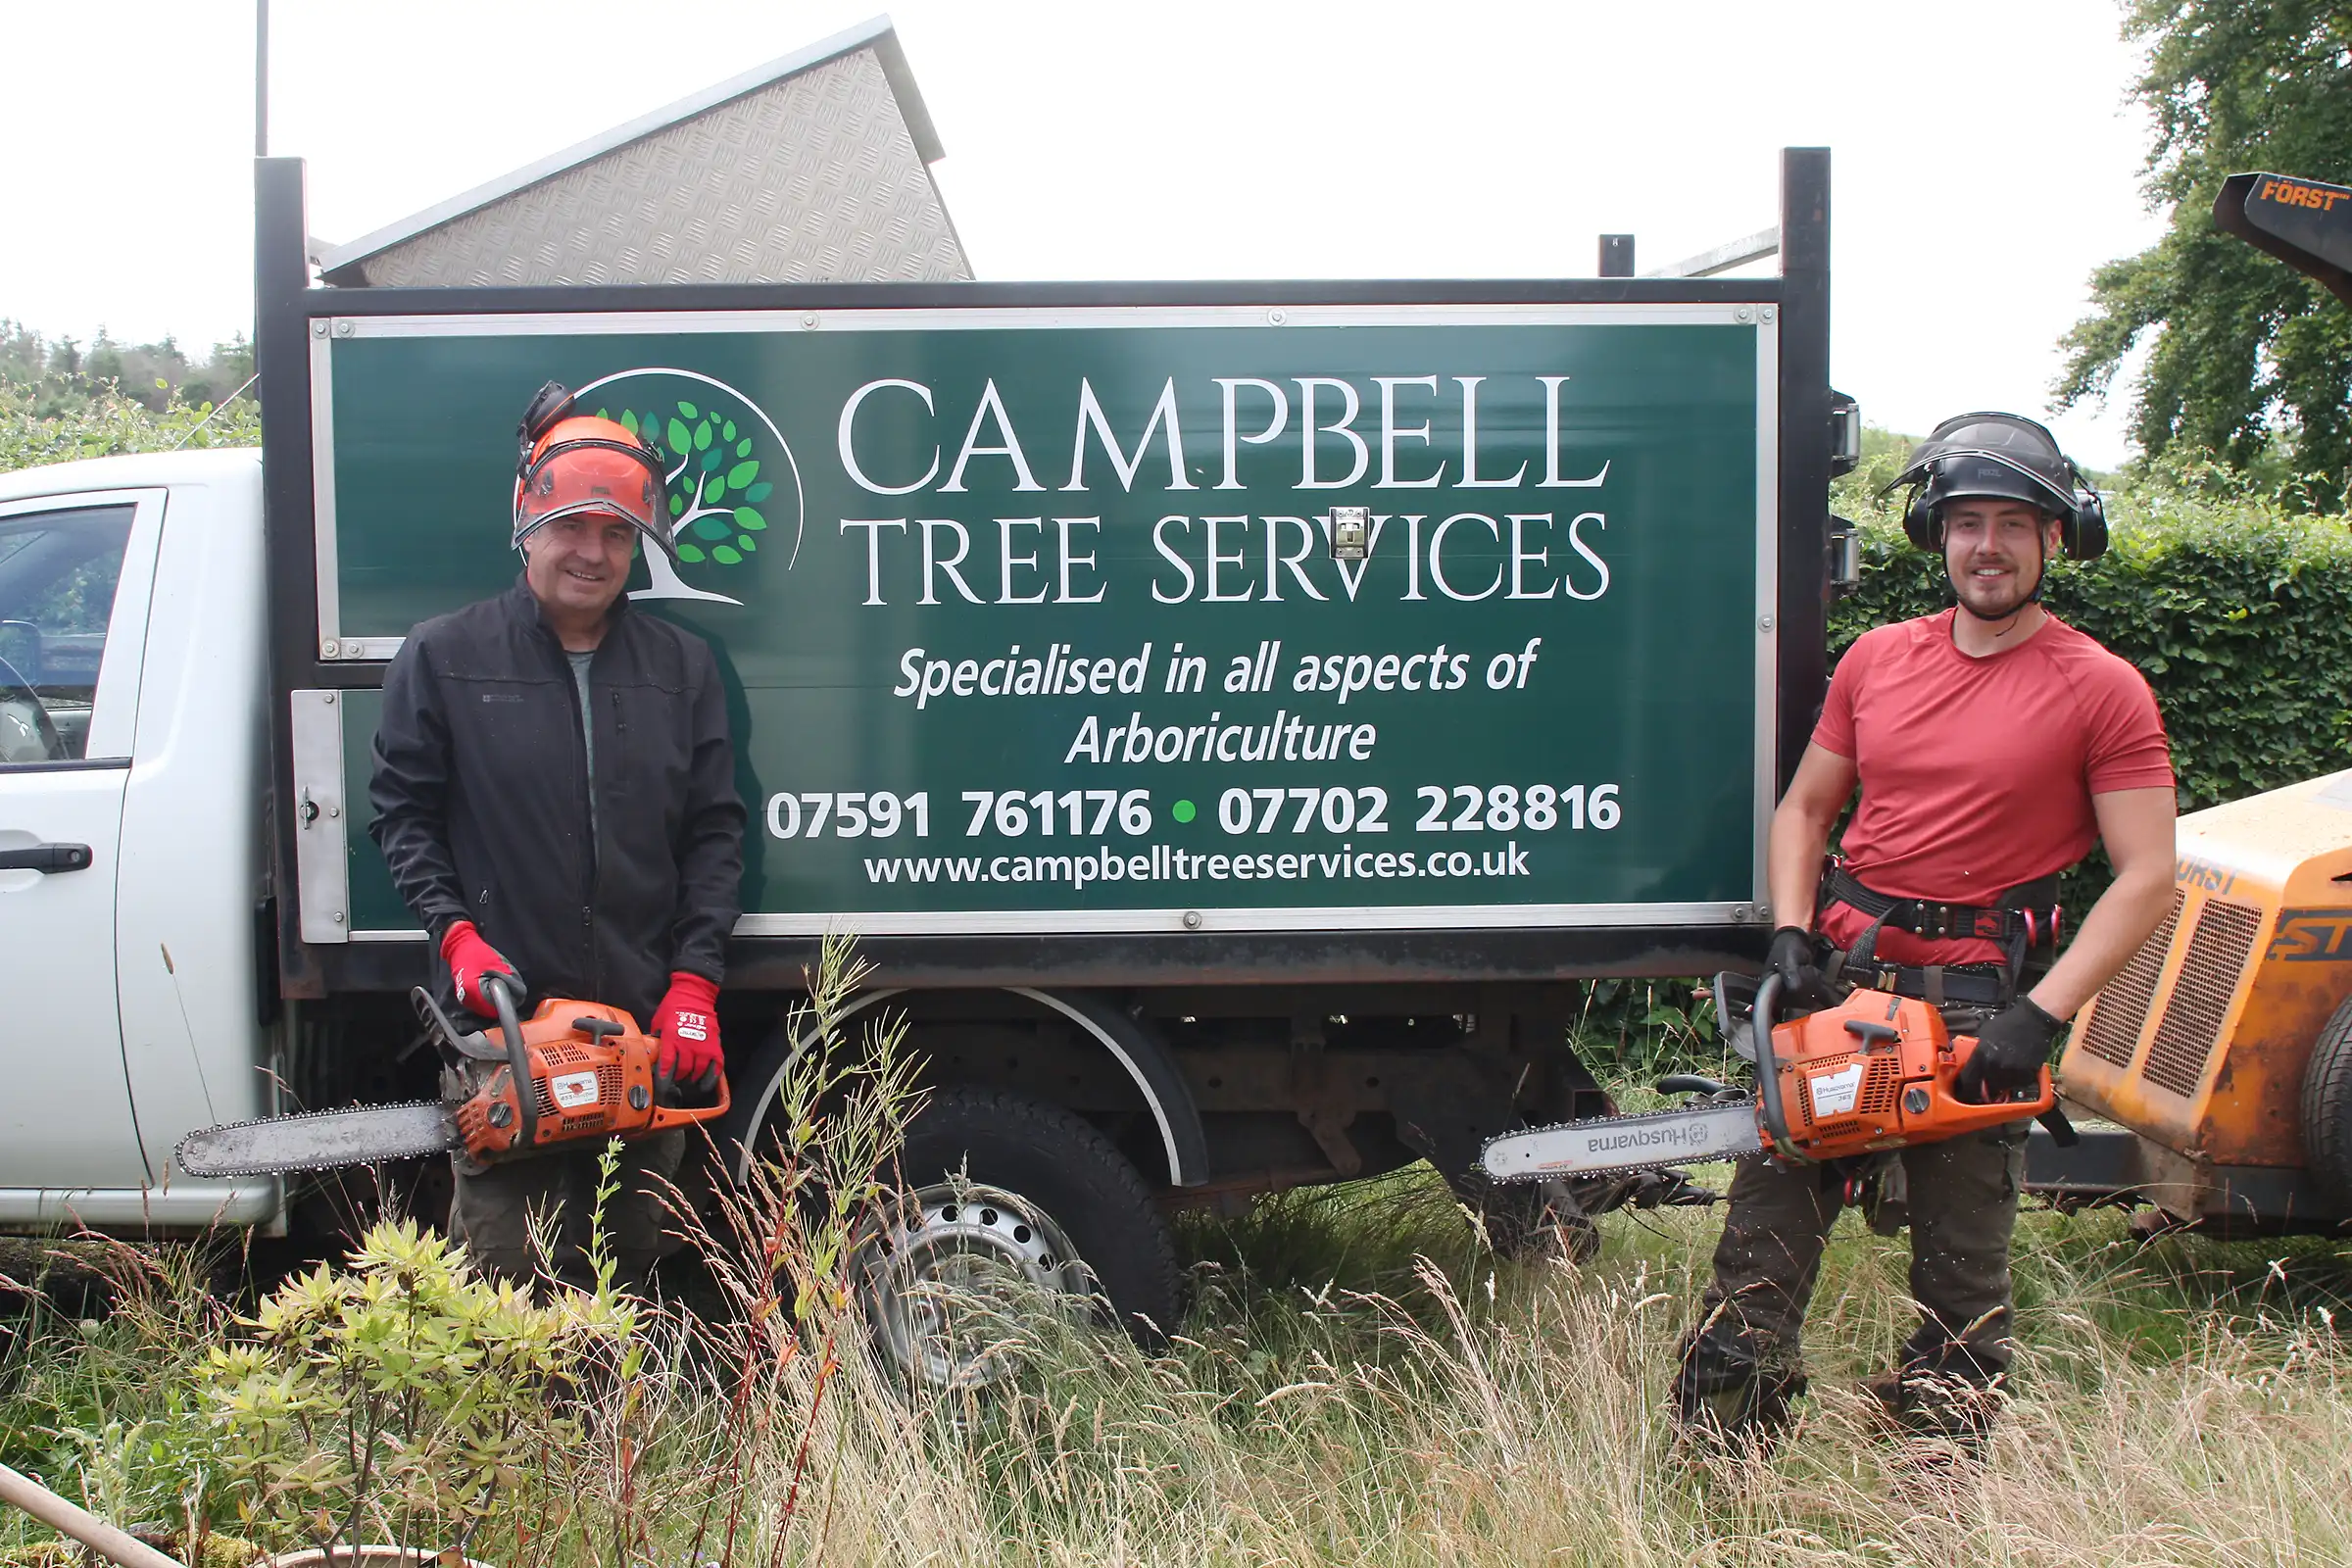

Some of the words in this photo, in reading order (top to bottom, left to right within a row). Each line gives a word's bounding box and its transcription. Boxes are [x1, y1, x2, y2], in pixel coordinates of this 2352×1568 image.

[2260, 180, 2336, 211] FÖRST
[838, 373, 1611, 495] CAMPBELL
[840, 515, 1107, 606] TREE
[1152, 511, 1610, 604] SERVICES
[893, 642, 1152, 710] Specialised
[1164, 642, 1207, 693] in
[1223, 640, 1282, 693] all
[1293, 644, 1470, 705] aspects
[1485, 637, 1542, 690] of
[1063, 710, 1376, 763] Arboriculture
[766, 790, 930, 839] 07591
[960, 789, 1152, 837] 761176
[1218, 786, 1389, 835] 07702
[1415, 783, 1621, 832] 228816
[863, 840, 1531, 890] www.campbelltreeservices.co.uk
[1588, 1127, 1687, 1152] Husqvarna
